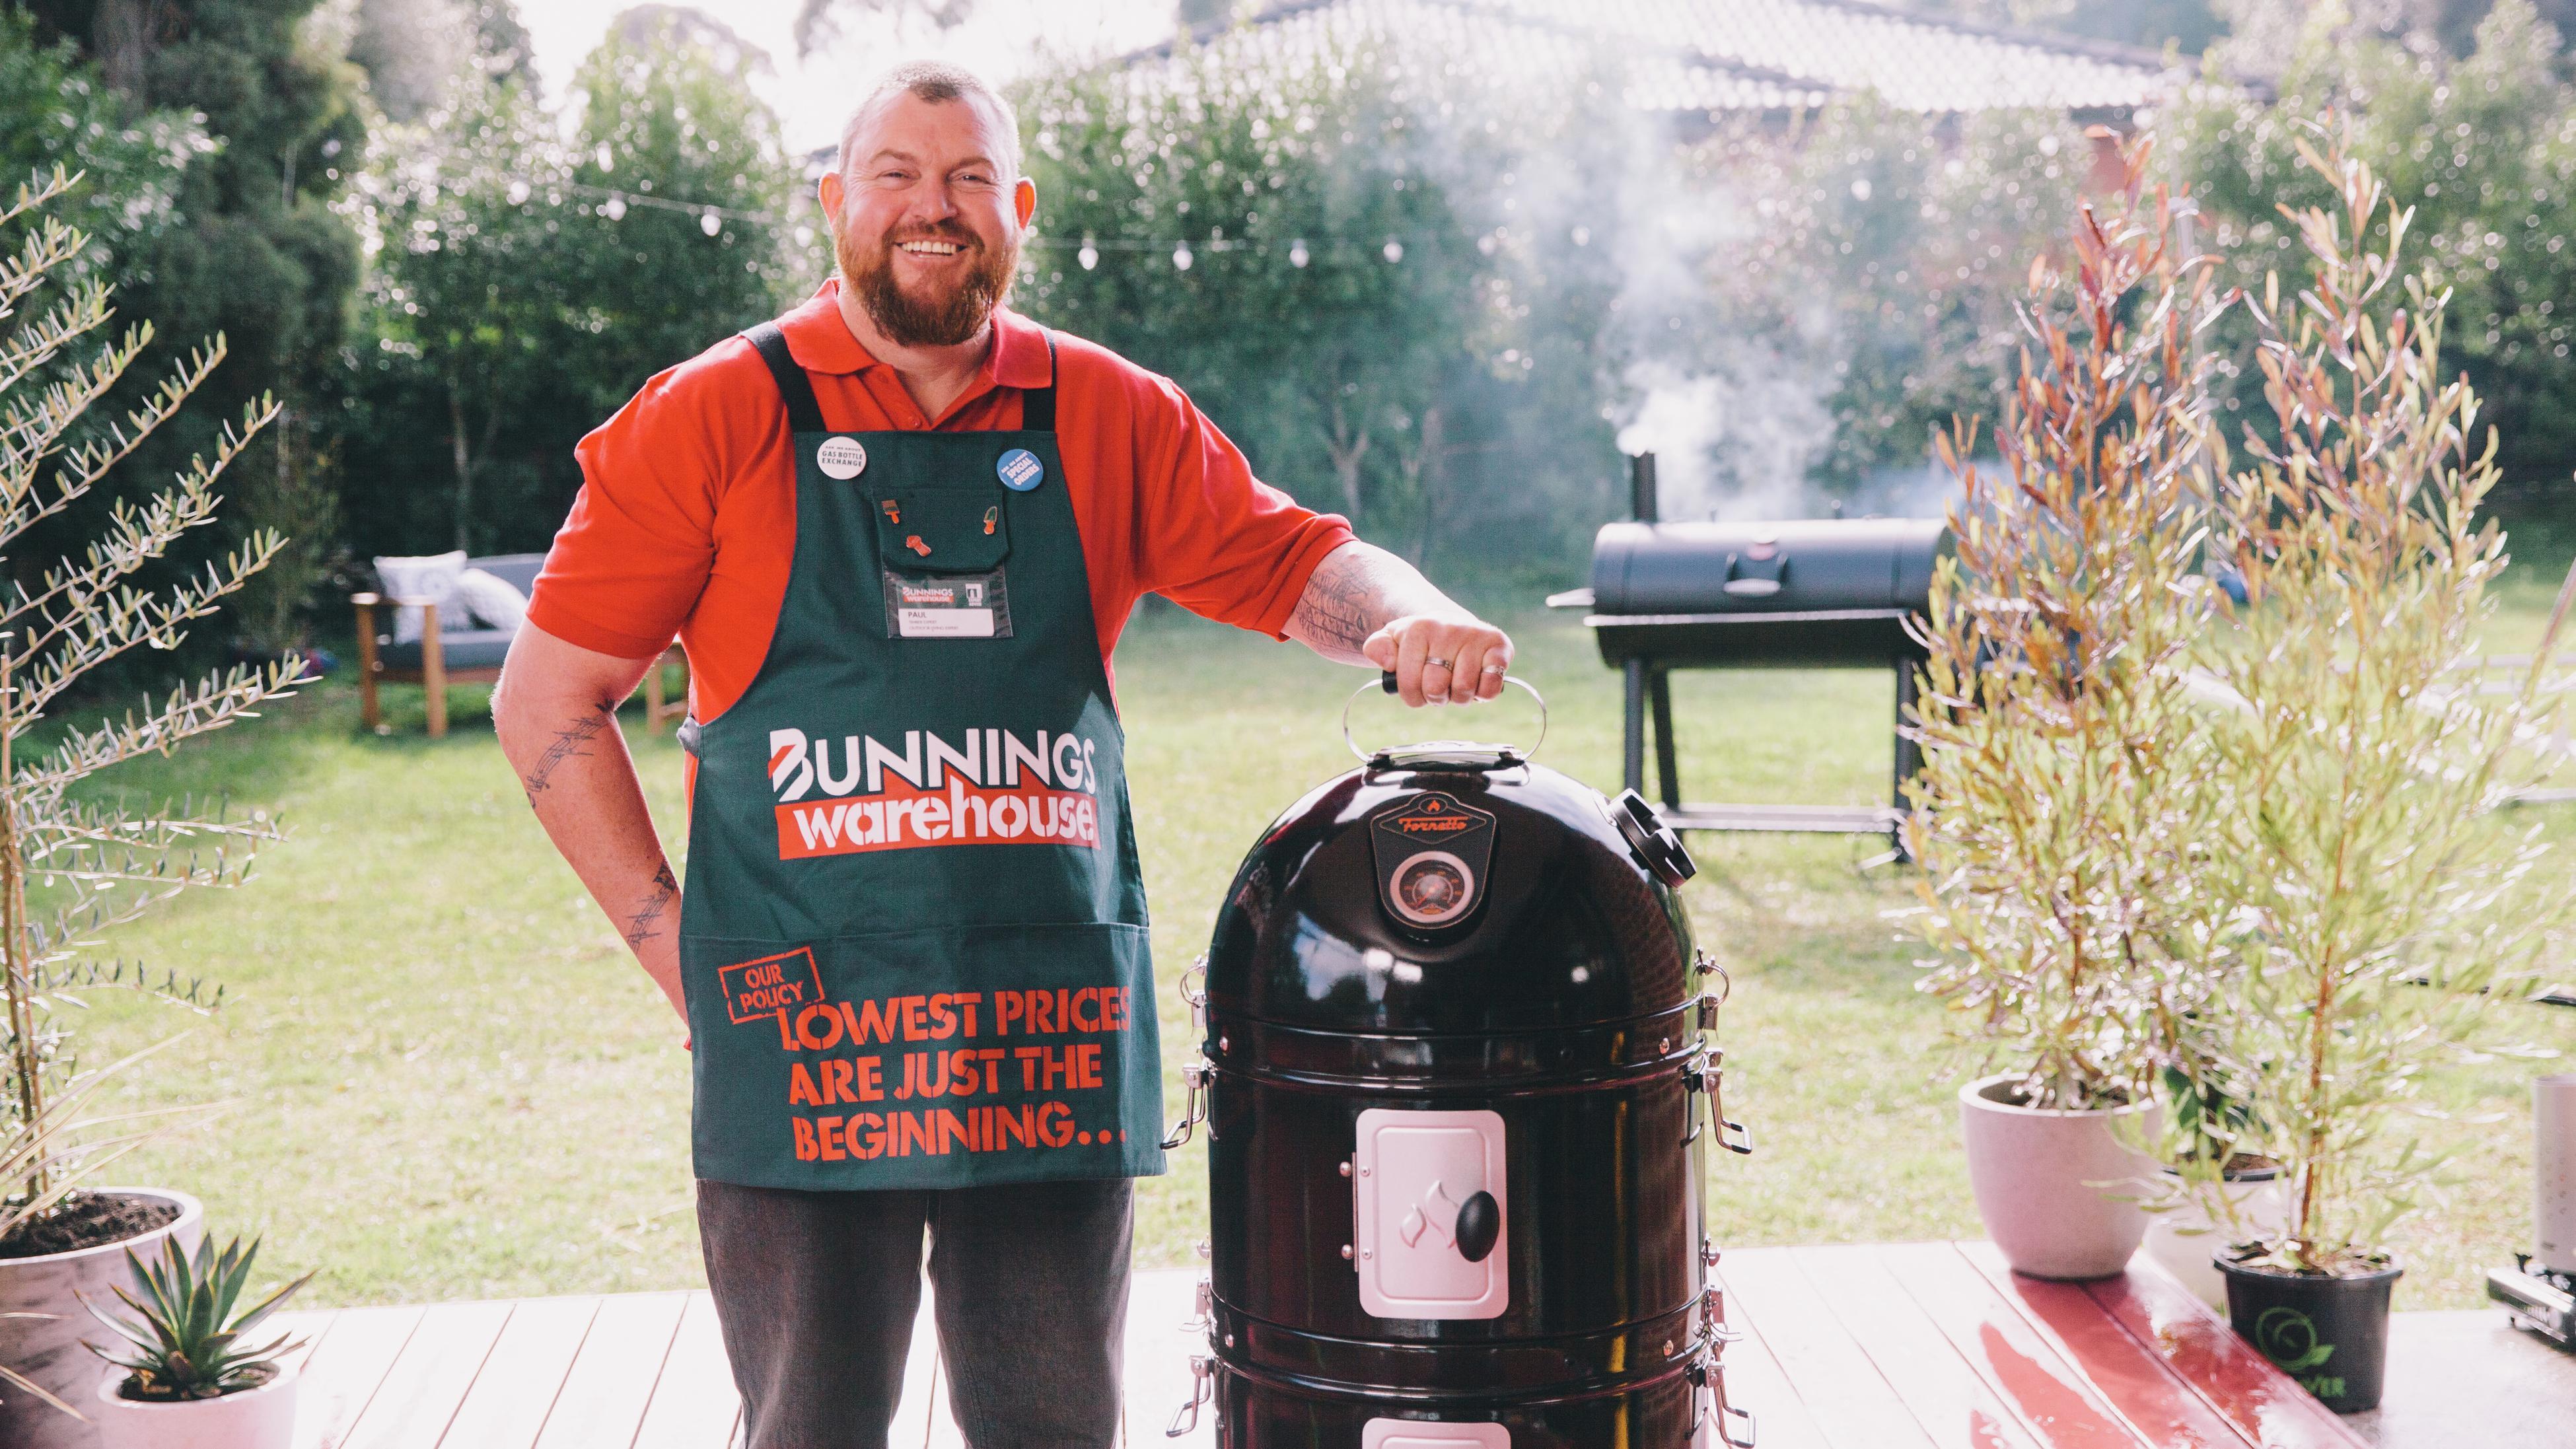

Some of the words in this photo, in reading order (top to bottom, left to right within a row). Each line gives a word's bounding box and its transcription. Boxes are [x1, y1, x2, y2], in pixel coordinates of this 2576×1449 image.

[822, 458, 862, 467] EXCHANGE
[1006, 457, 1034, 479] SPECIAL
[1013, 464, 1040, 485] ORDERS
[902, 586, 954, 596] BUNNINGS
[768, 728, 1097, 802] BUNNINGS
[793, 775, 1095, 851] warehouse
[1398, 816, 1470, 832] Fornetto
[744, 963, 785, 987] OUR
[739, 979, 803, 1012] POLICY
[775, 992, 982, 1051] LOWEST
[994, 985, 1131, 1037] PRICES
[789, 1055, 885, 1107] ARE
[893, 1048, 1005, 1100] JUST
[1014, 1043, 1103, 1092] THE
[792, 1101, 1127, 1162] BEGINNING...
